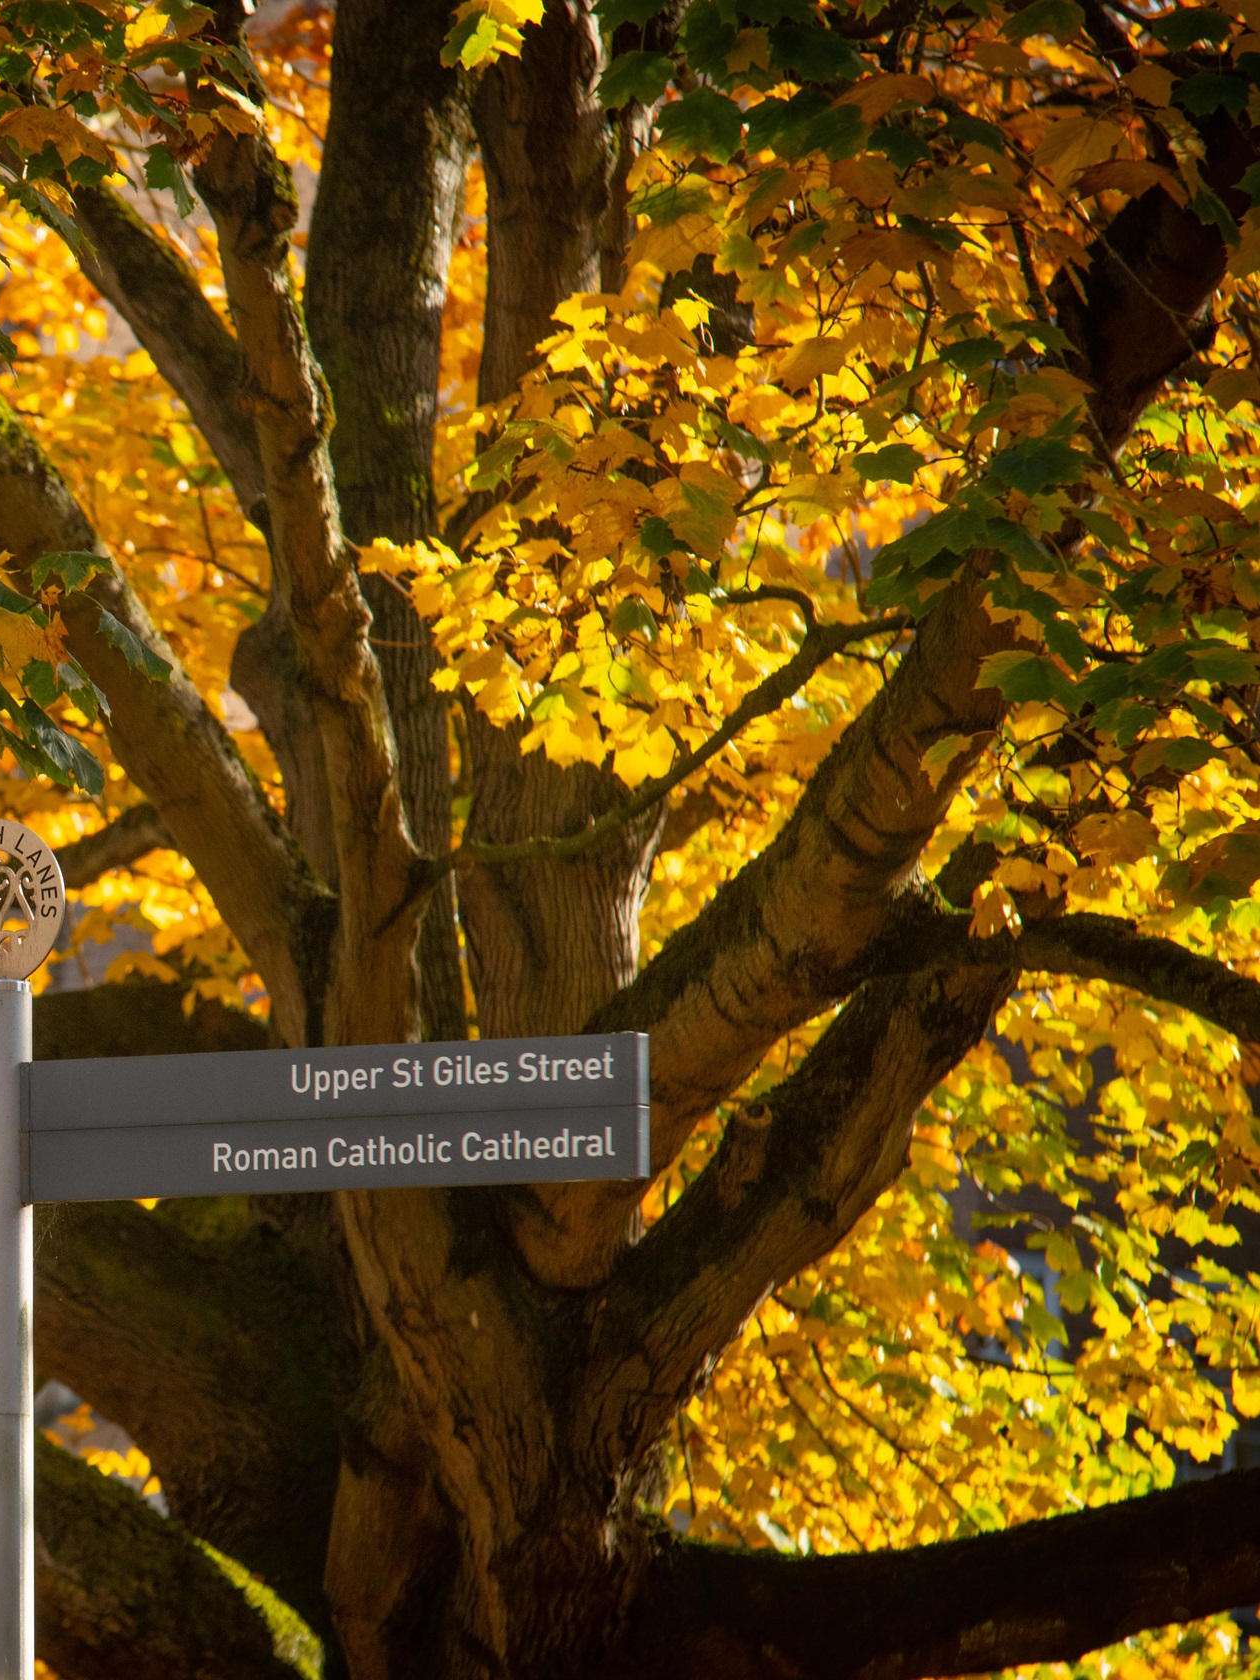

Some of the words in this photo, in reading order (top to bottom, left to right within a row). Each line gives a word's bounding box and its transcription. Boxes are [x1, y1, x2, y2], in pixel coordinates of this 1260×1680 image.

[14, 833, 58, 918] LANES
[291, 1063, 385, 1101] Upper
[392, 1058, 424, 1088] St
[433, 1055, 510, 1086] Giles
[517, 1051, 615, 1083] Street
[213, 1142, 317, 1173] Roman
[328, 1133, 452, 1168] Catholic
[461, 1126, 616, 1162] Cathedral
